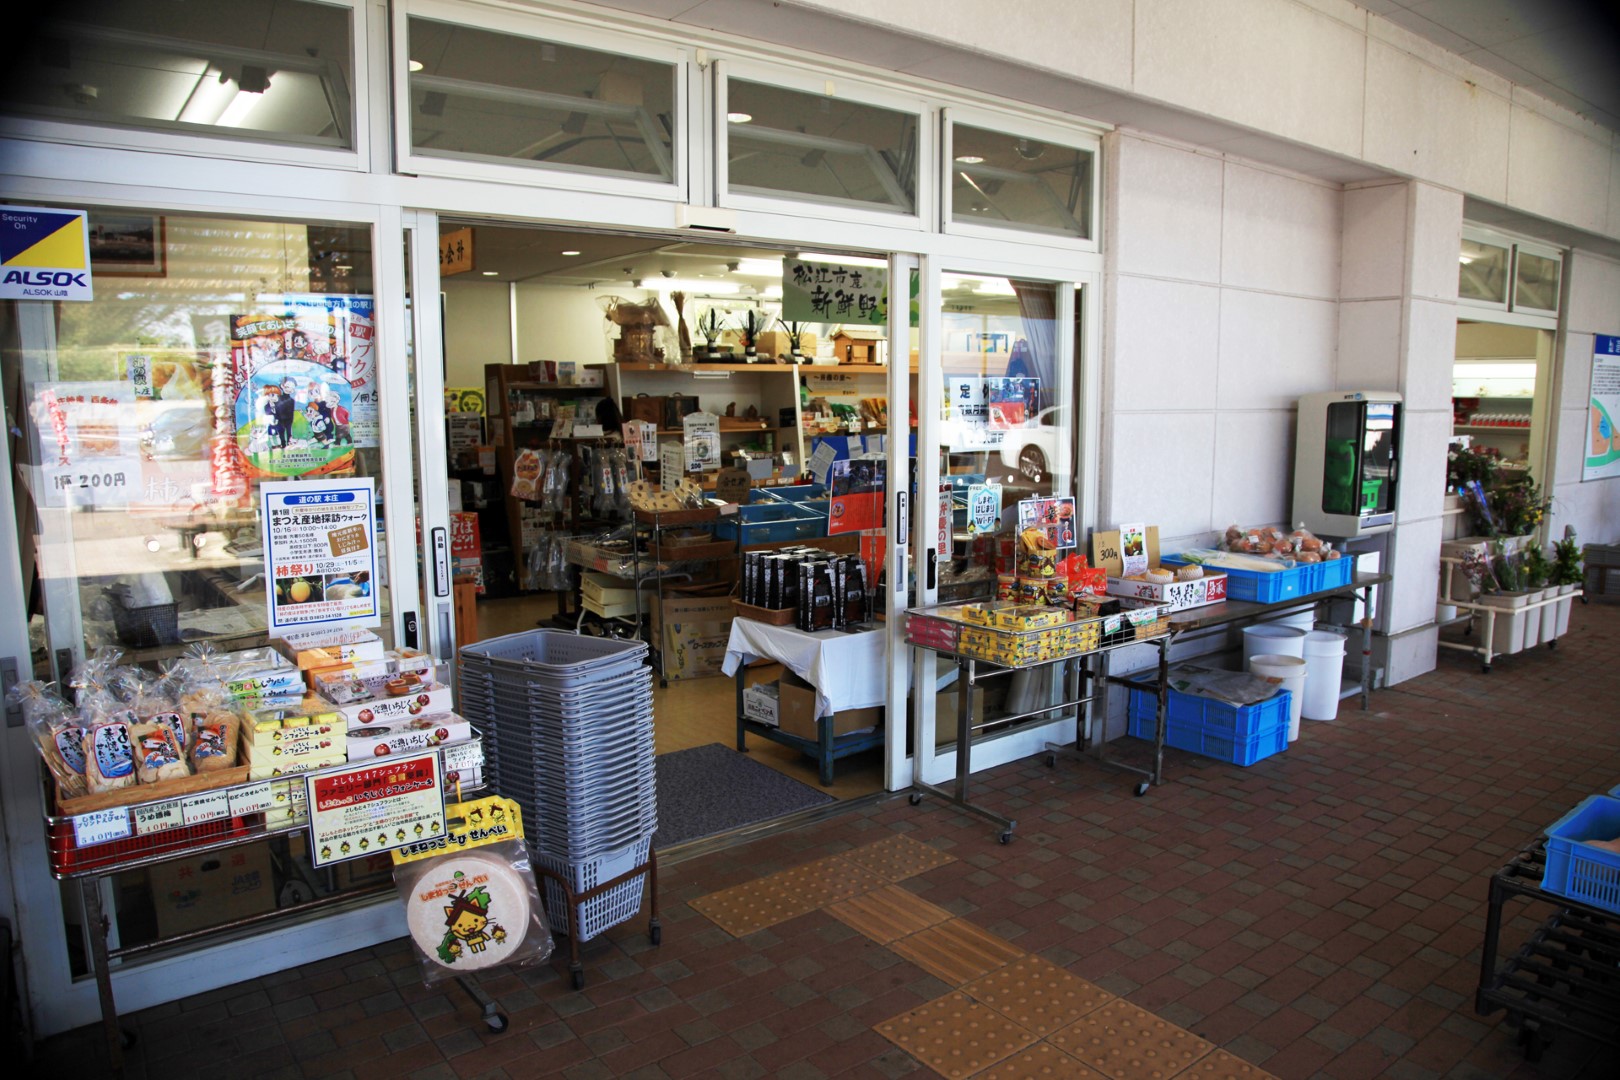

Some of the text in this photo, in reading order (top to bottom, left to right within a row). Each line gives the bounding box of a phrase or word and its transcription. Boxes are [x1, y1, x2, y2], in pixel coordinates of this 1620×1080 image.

[2, 213, 37, 223] Security
[14, 222, 27, 230] On
[3, 270, 87, 287] ALSOK
[793, 265, 862, 289] 松江市産
[23, 288, 52, 296] ALSOK
[80, 472, 126, 488] 200円
[299, 494, 339, 504] 道の駅 本庄
[975, 505, 995, 514] はじまり
[272, 513, 368, 527] まつえ産地探訪ウォーク
[938, 501, 948, 555] 弁慶の里
[275, 563, 314, 577] 柿祭り
[372, 699, 411, 715] 完熟いちじく
[283, 730, 320, 740] シフォンケーキ
[389, 733, 430, 749] 完熟いちじく
[283, 745, 320, 755] シフォンケーキ
[332, 763, 417, 786] よしもと47シュフラン
[354, 789, 384, 801] いちじく
[385, 778, 434, 794] シフォンケーキ
[401, 838, 447, 857] しまねっこ
[449, 832, 467, 846] えび
[469, 825, 508, 840] せんべい
